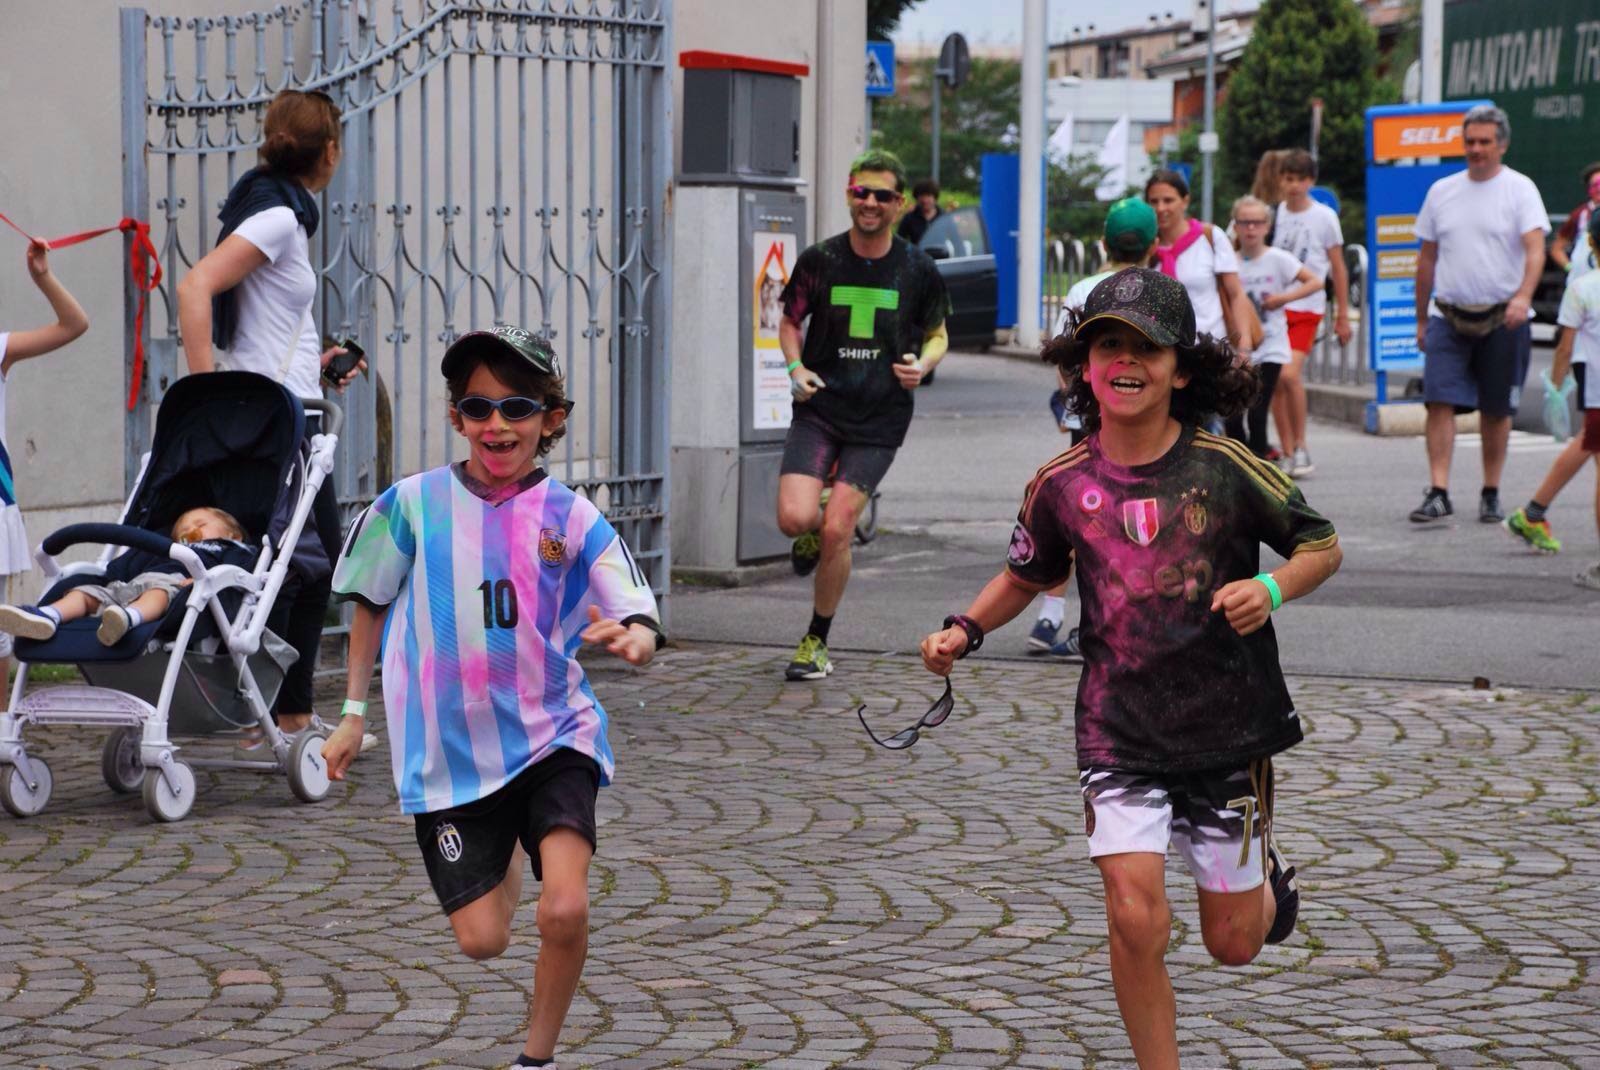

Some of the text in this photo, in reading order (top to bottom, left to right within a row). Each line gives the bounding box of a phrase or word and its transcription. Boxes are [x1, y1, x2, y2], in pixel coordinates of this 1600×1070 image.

[1447, 26, 1562, 97] MANTOAN
[1399, 125, 1463, 146] SELF
[830, 286, 899, 339] T
[837, 347, 881, 360] SHIRT
[477, 579, 518, 629] 10
[1226, 796, 1257, 869] 7
